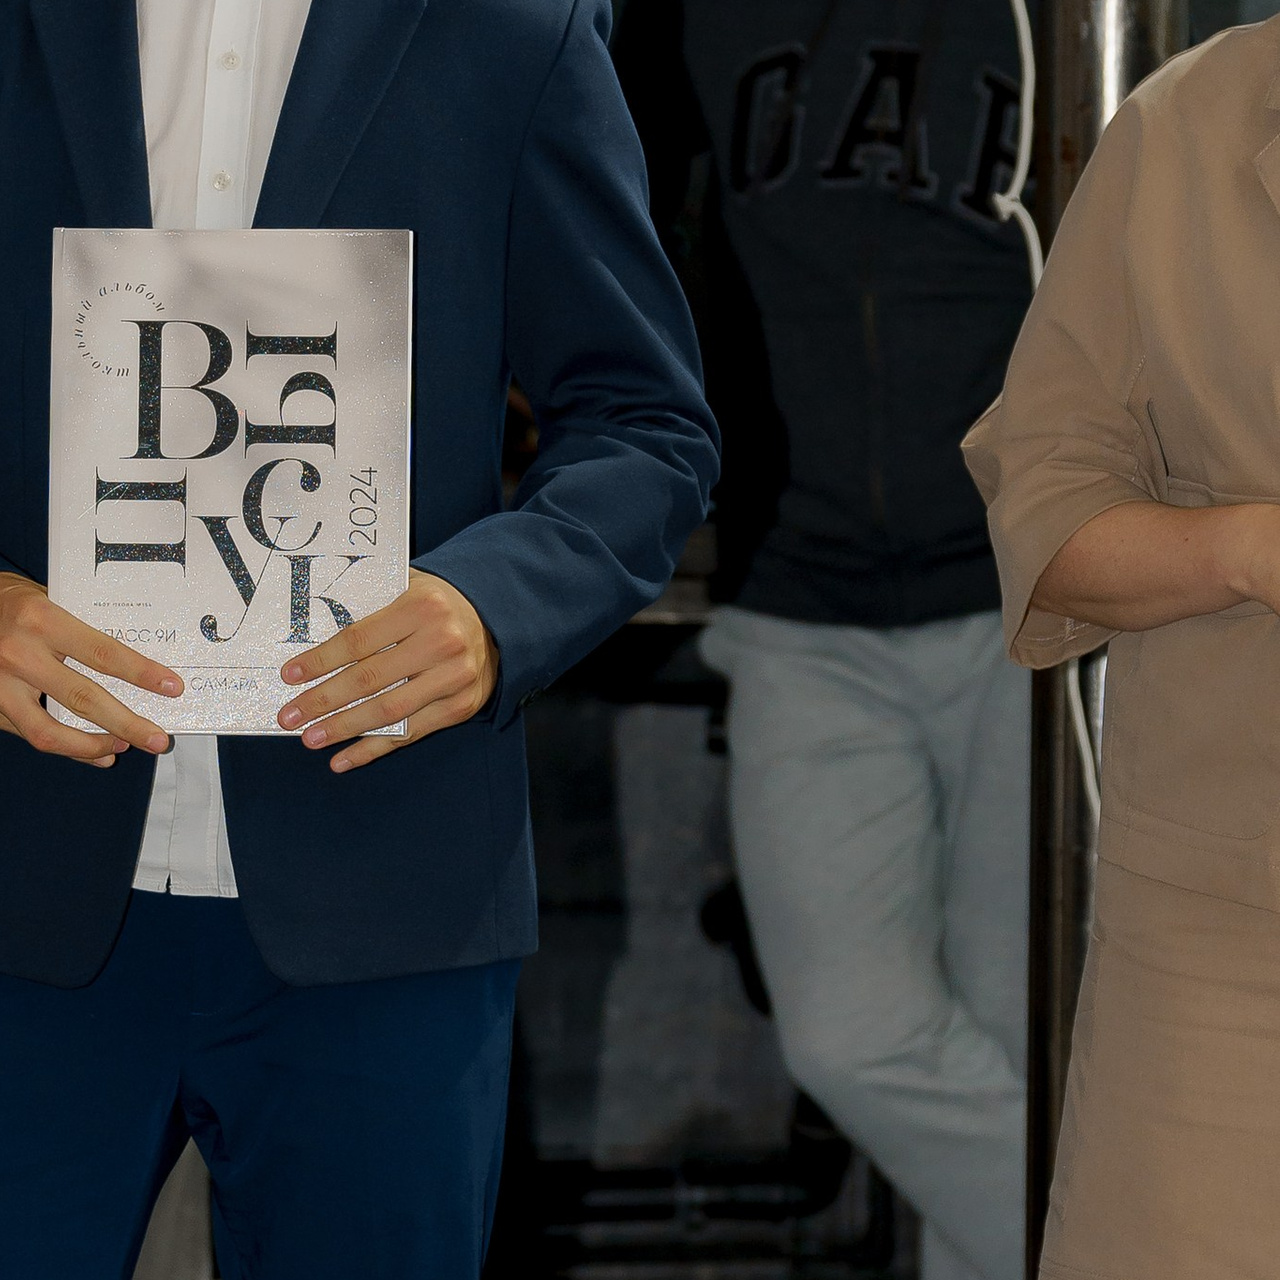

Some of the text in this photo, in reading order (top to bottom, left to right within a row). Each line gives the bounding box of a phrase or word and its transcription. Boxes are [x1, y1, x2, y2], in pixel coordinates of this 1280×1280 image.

[74, 282, 165, 377] школьный альбом
[348, 466, 378, 546] 2024
[104, 628, 176, 643] ЛАСС 9И
[190, 677, 259, 691] САМАРА
